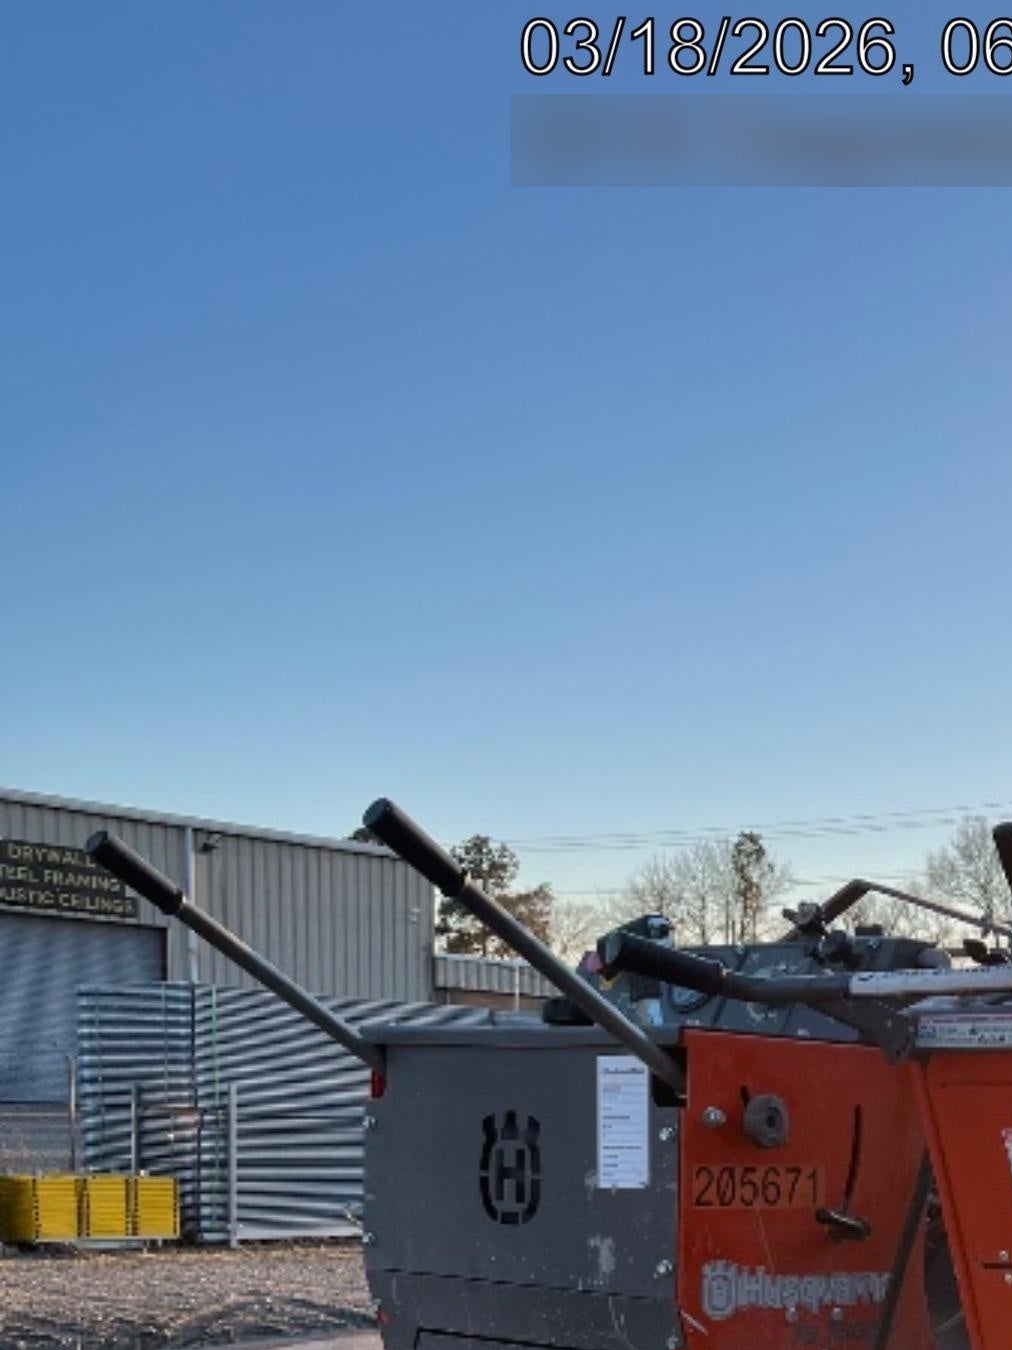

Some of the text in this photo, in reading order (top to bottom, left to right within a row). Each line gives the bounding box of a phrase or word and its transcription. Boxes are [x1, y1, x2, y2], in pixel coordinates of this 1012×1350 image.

[8, 844, 96, 868] DRYWALL
[44, 870, 120, 892] FRAMING
[695, 1165, 818, 1207] 205671
[737, 1266, 891, 1313] Husqvarn
